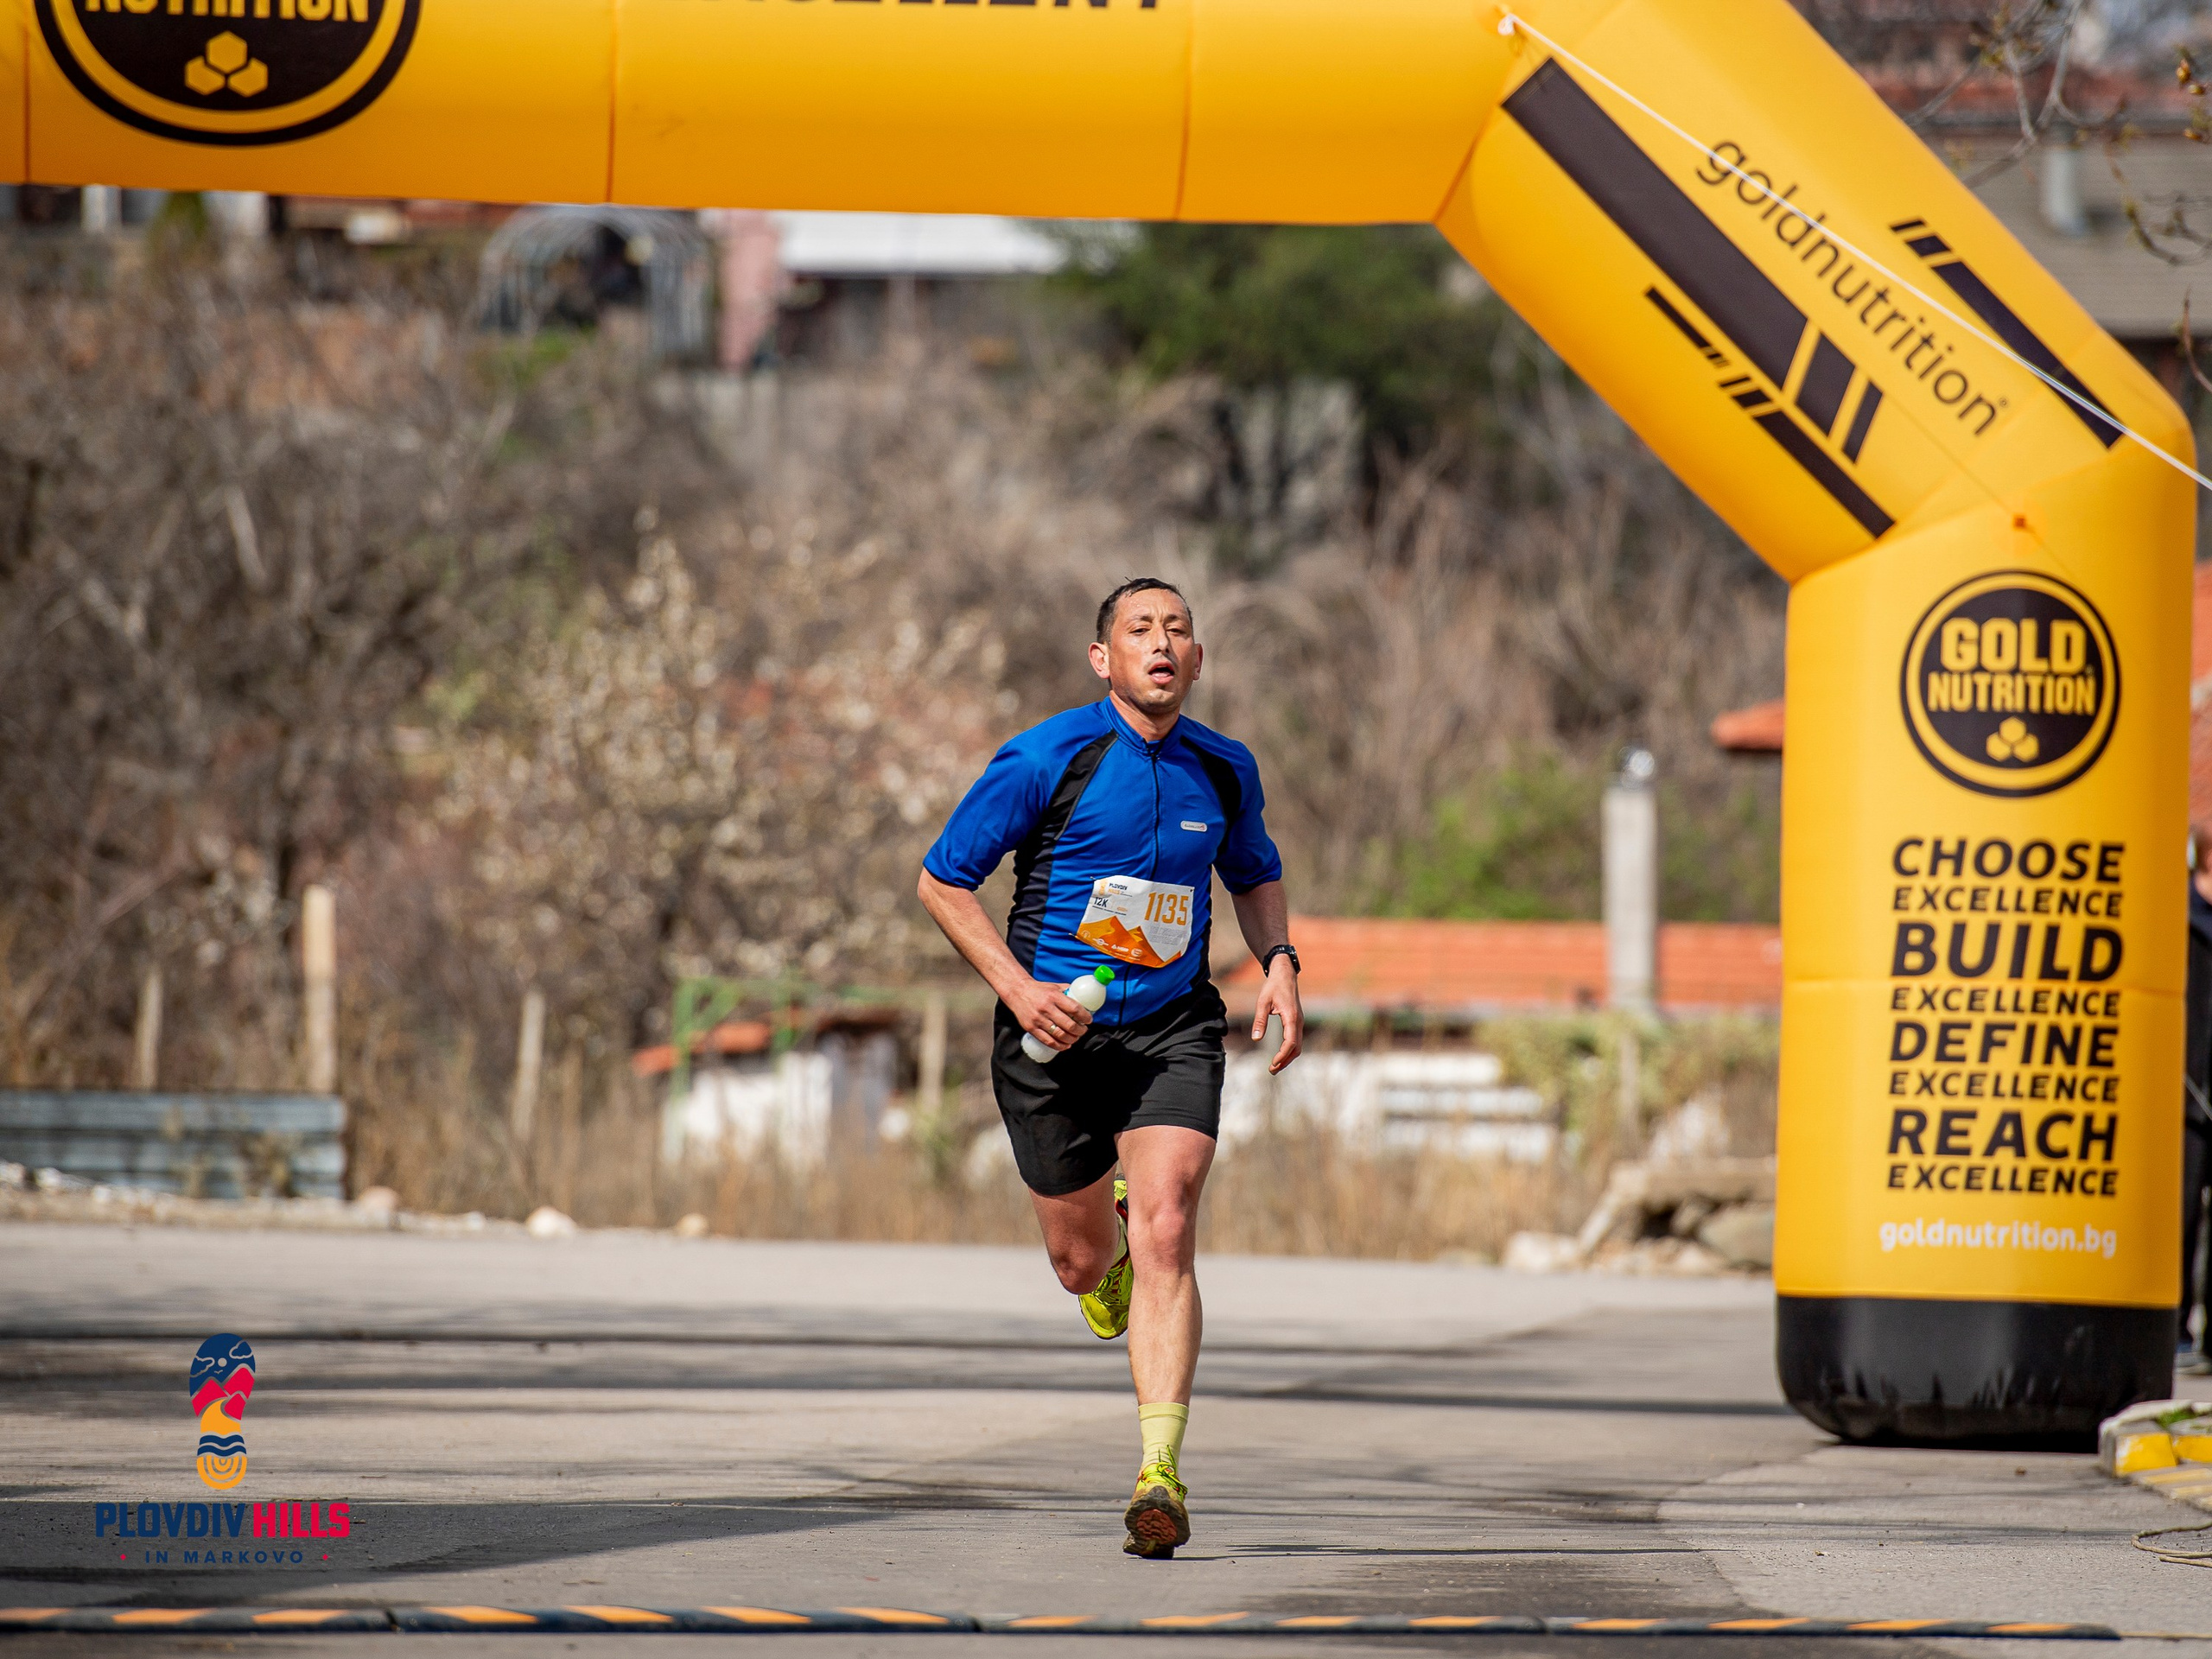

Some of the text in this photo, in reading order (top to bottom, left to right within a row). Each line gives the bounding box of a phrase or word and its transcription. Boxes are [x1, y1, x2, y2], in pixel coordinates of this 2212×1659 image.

[1695, 142, 1999, 436] goldnutrition
[1940, 617, 2087, 675] GOLD
[1927, 672, 2096, 715] NUTRITION
[1891, 836, 2126, 883] CHOOSE
[1093, 897, 1109, 907] 12K
[1144, 891, 1189, 926] 1135
[1892, 886, 2124, 918] EXCELLENCE
[1890, 921, 2125, 982] BUILD
[1890, 986, 2121, 1017] EXCELLENCE
[1889, 1021, 2119, 1068] DEFINE
[1888, 1071, 2120, 1103] EXCELLENCE
[1887, 1109, 2118, 1161] REACH
[1887, 1164, 2119, 1198] EXCELLENCE
[1879, 1218, 2117, 1258] goldnutrition.bg
